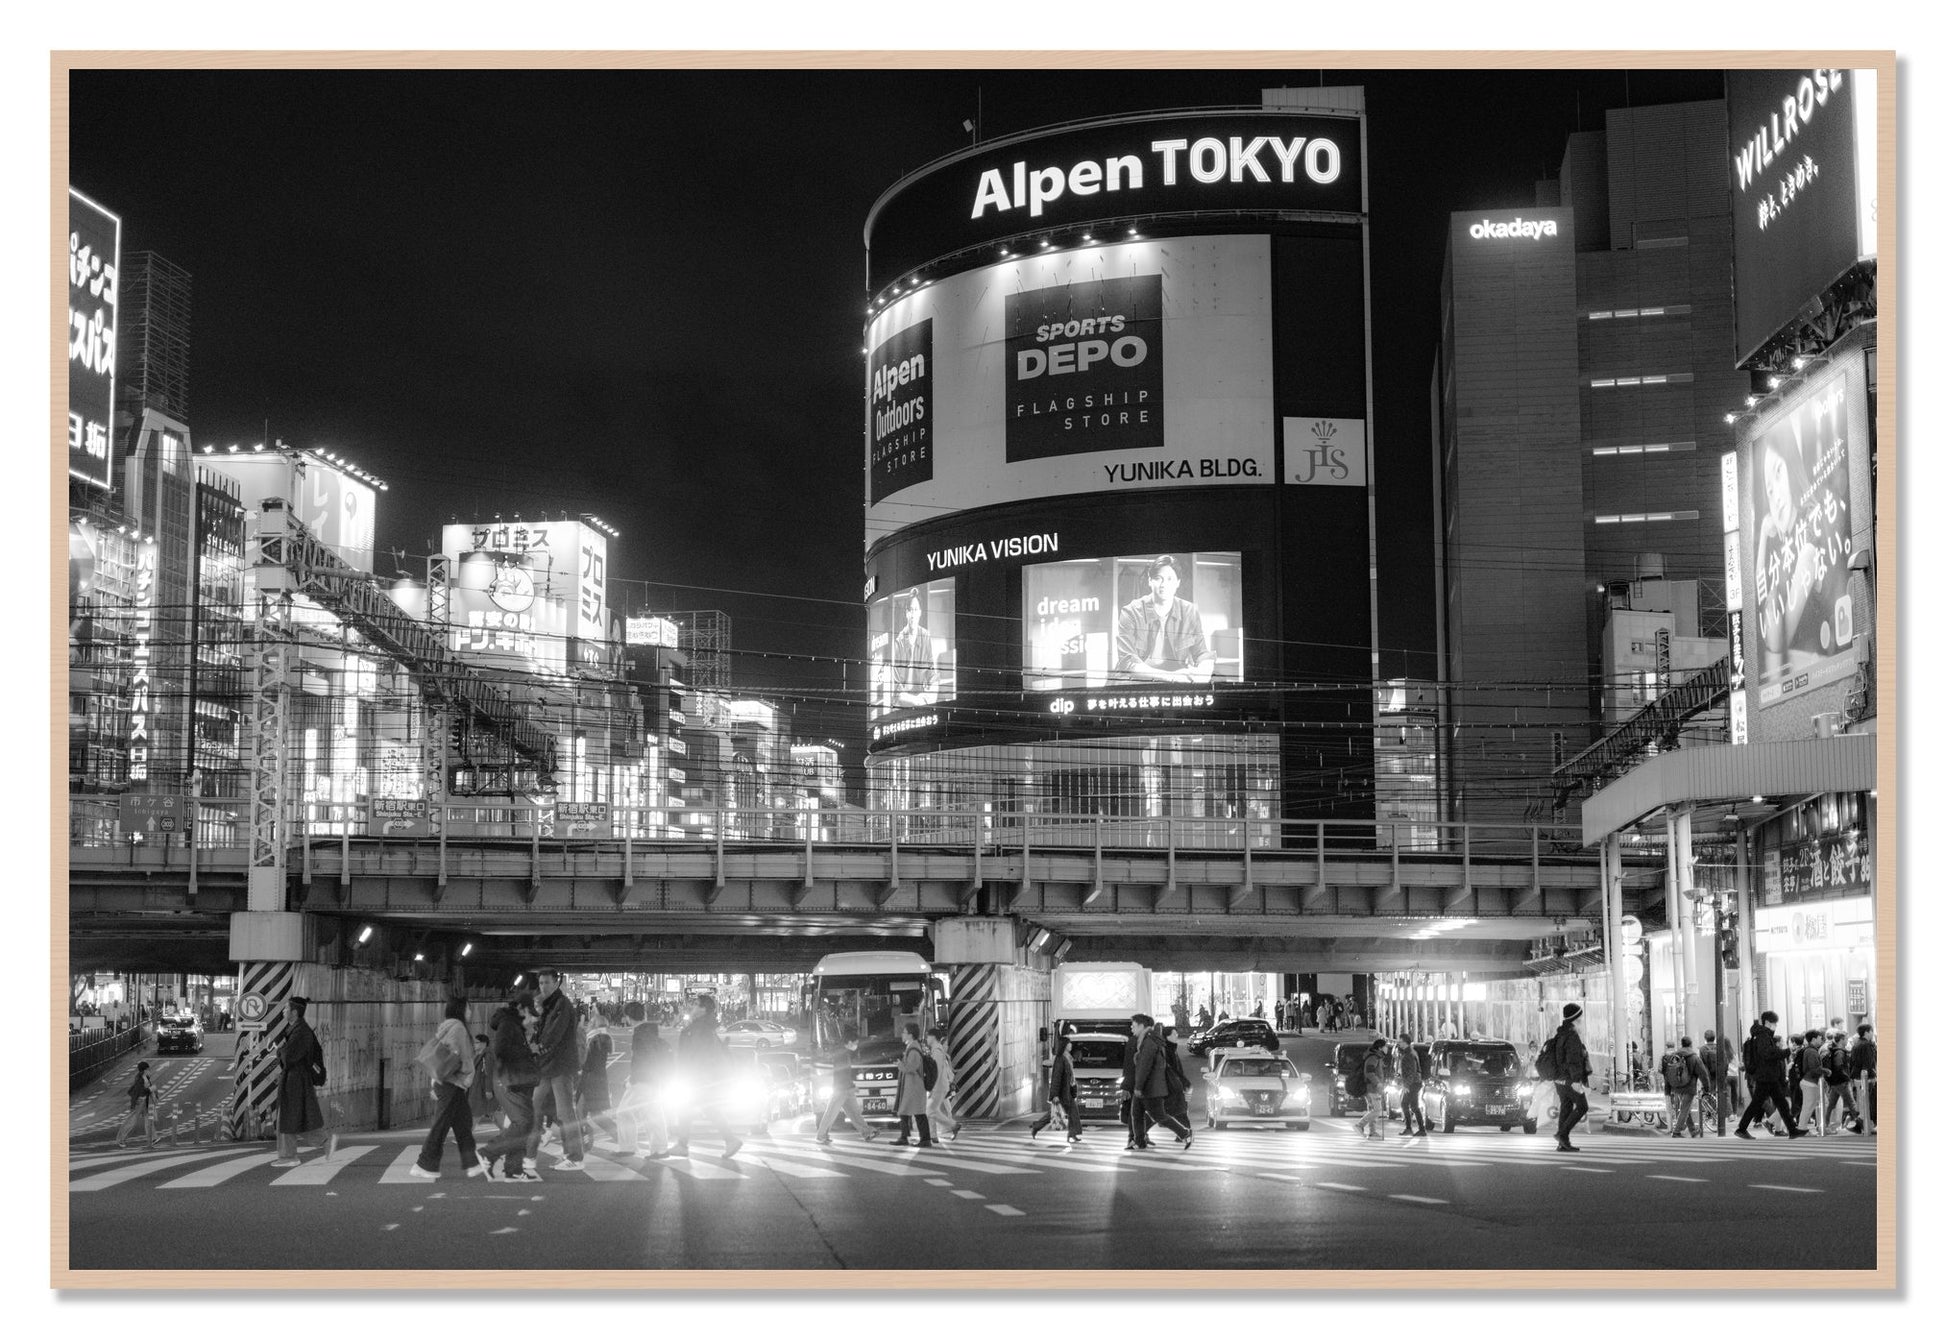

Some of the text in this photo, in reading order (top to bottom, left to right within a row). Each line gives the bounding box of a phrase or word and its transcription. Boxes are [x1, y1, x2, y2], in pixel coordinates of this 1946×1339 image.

[970, 135, 1342, 219] Alpen TOKYO
[1469, 217, 1558, 242] okadaya
[1036, 315, 1126, 343] SPORTS
[1017, 335, 1148, 381] DEPO
[872, 353, 925, 405] Alpen
[1017, 390, 1148, 417] FLAGSHIP
[876, 395, 925, 441] Outdoors
[1064, 410, 1148, 430] STORE
[872, 427, 926, 465] FLAGSHIP
[887, 446, 926, 473] STORE
[1104, 459, 1263, 483] YUNIKA BLDG.
[206, 533, 240, 557] SHISHA
[472, 528, 550, 550] プロミス
[926, 532, 1059, 572] YUNIKA VISION
[1037, 596, 1100, 616] dream
[1050, 694, 1215, 714] dip 夢を叶える仕事に出会おう
[373, 800, 425, 811] 新宿駅東口
[557, 802, 606, 814] 新宿駅東口
[559, 813, 584, 821] Shinjuku
